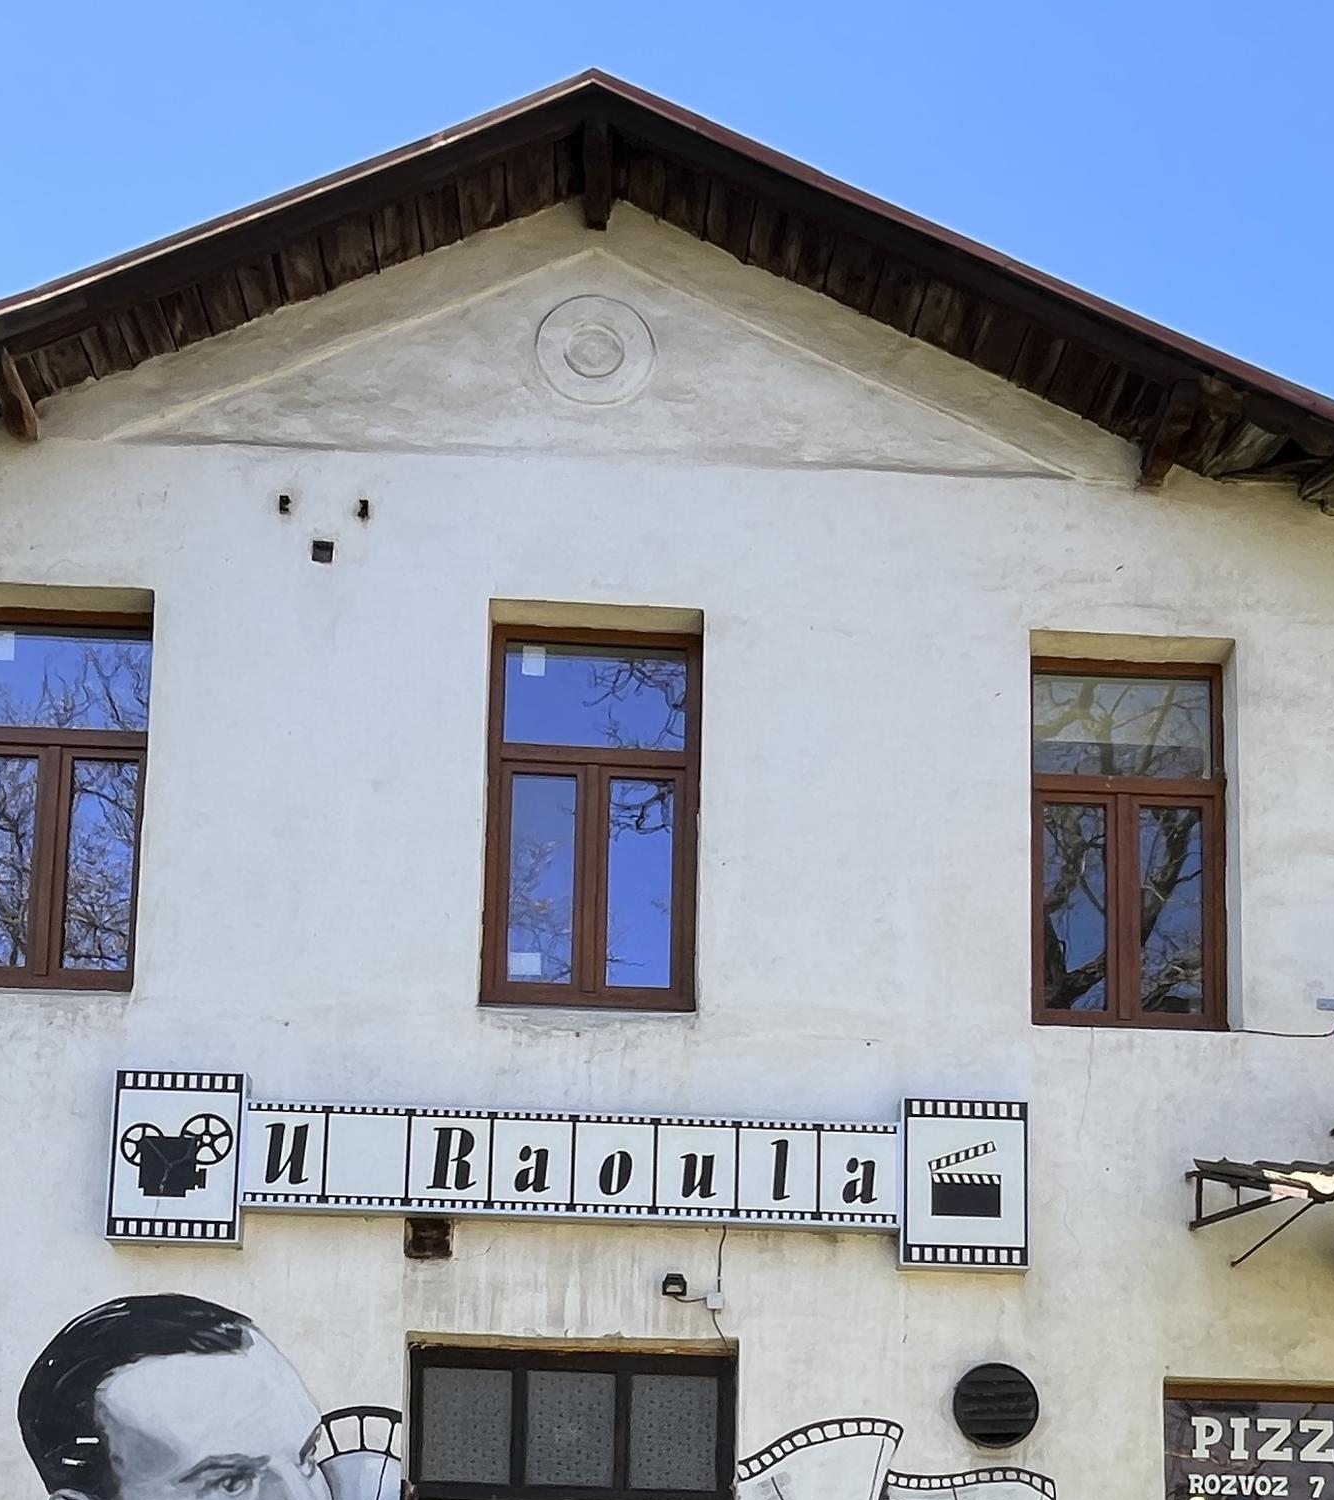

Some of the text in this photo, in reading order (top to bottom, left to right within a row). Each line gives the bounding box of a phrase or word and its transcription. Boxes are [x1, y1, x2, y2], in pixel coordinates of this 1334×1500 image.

[264, 1121, 879, 1204] U Raoula
[1188, 1474, 1289, 1498] ROZVOZ
[1309, 1476, 1326, 1499] 7
